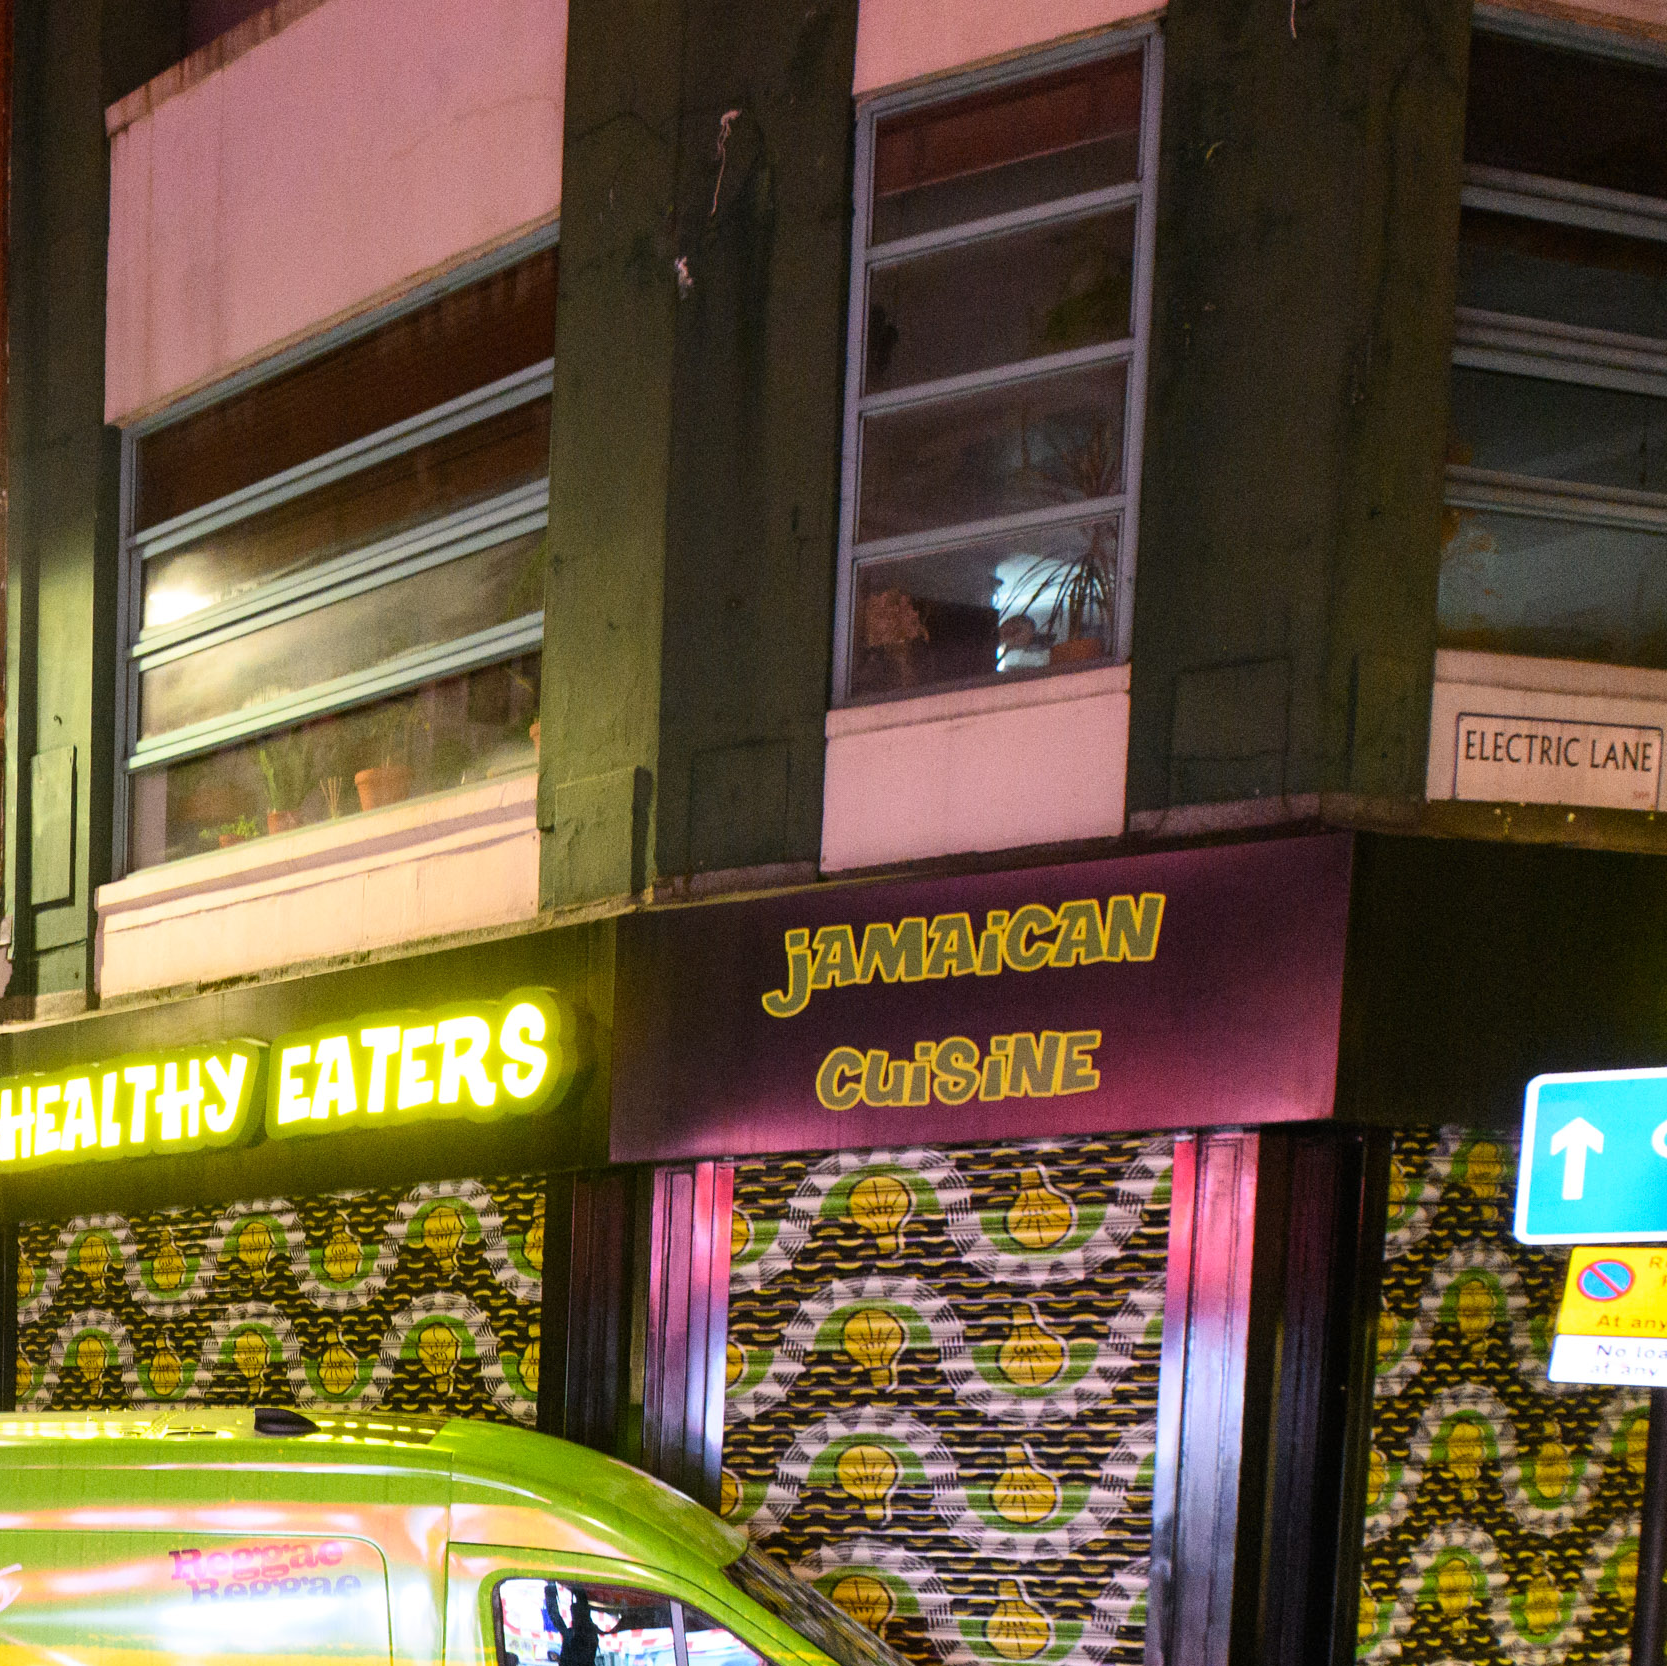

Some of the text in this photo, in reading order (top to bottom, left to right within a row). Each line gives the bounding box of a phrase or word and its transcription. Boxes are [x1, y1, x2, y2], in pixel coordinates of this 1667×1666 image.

[1465, 730, 1652, 772] ELECTRIC LANE
[275, 1002, 549, 1126] EATERS
[1596, 1314, 1620, 1328] At
[1597, 1344, 1626, 1356] No
[168, 1540, 344, 1581] Reggae
